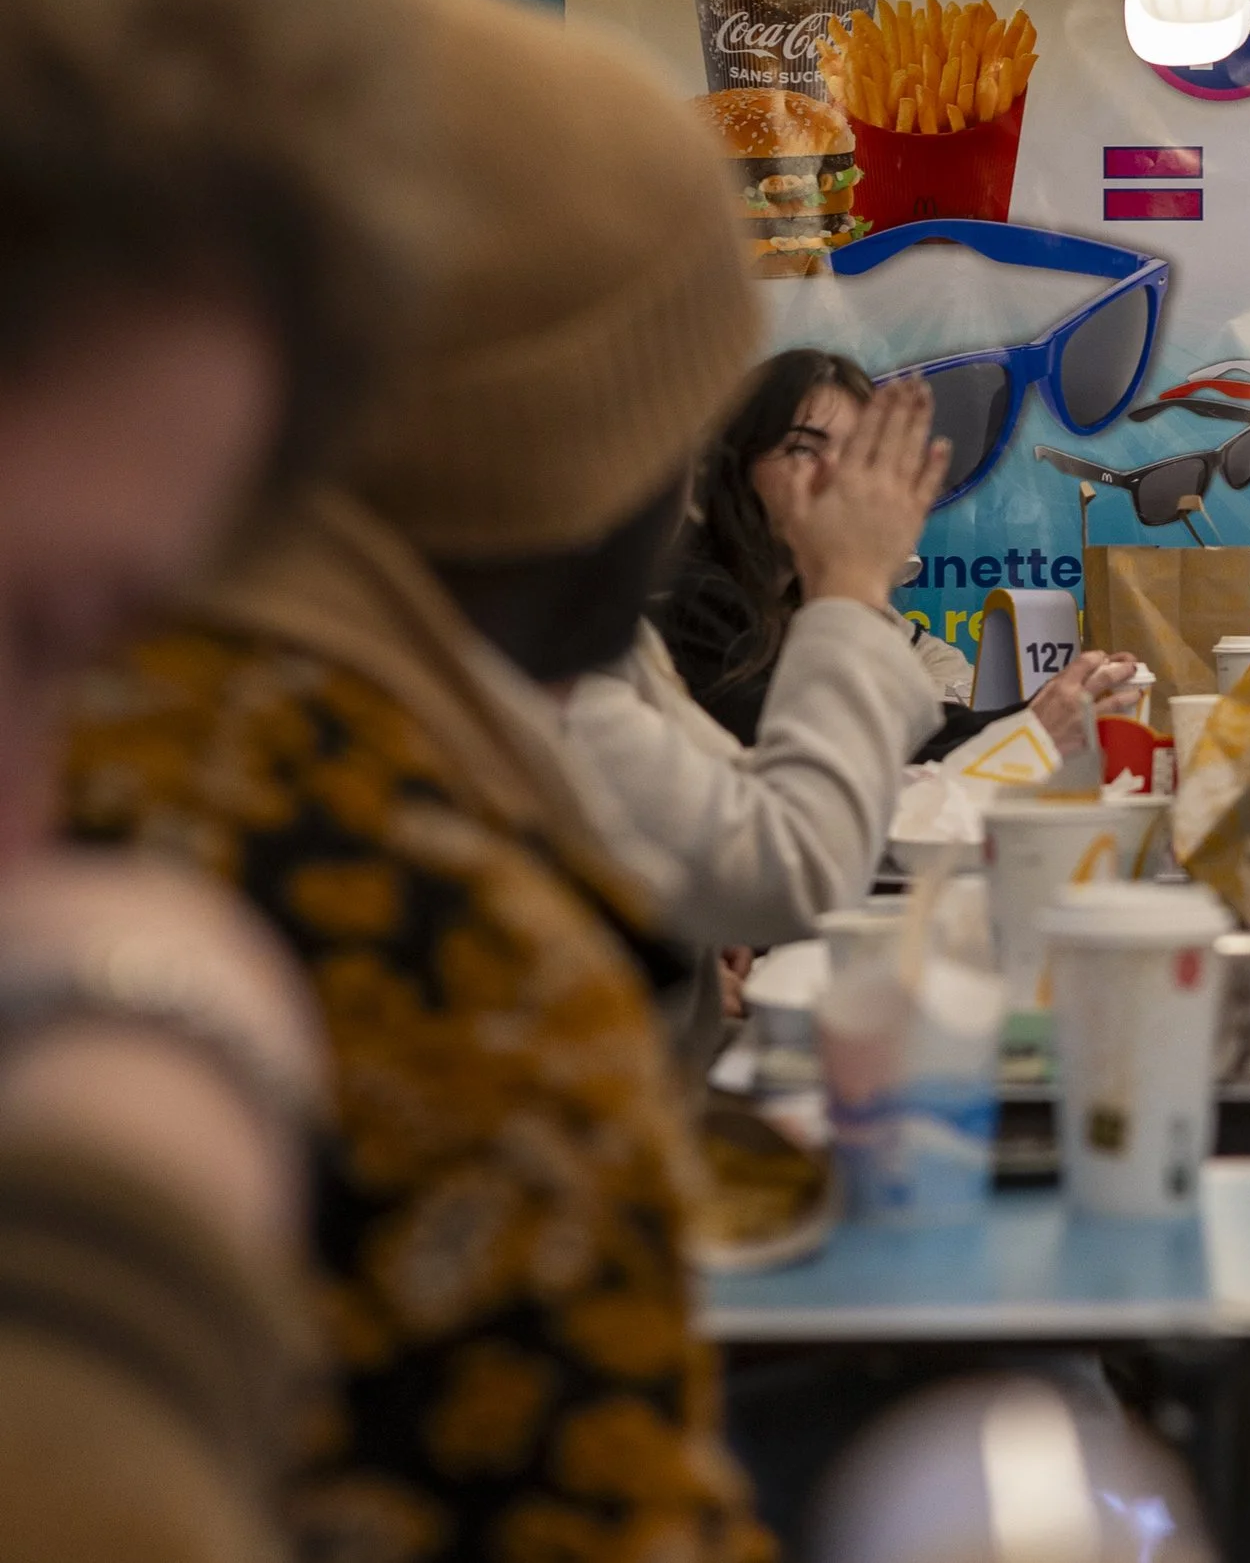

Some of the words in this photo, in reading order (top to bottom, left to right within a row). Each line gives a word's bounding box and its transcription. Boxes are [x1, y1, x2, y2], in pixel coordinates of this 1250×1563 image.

[729, 66, 774, 84] SANS
[778, 69, 826, 84] SUCR
[1025, 642, 1075, 674] 127
